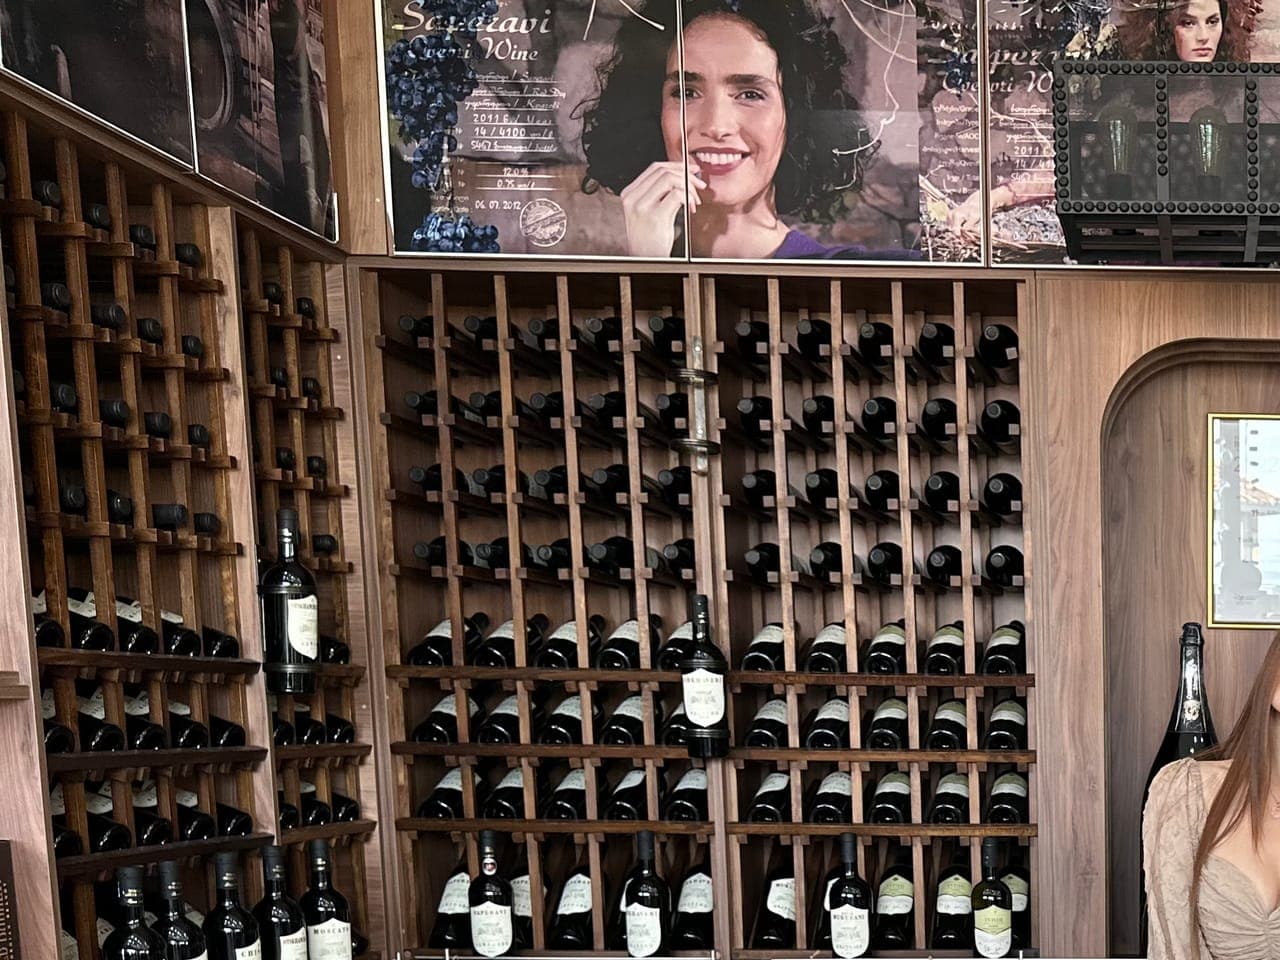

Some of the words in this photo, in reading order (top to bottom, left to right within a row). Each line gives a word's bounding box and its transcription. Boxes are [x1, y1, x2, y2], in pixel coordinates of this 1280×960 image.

[480, 37, 538, 61] Wine
[473, 113, 499, 122] 2011
[1014, 146, 1039, 155] 2011
[503, 200, 521, 210] 2012
